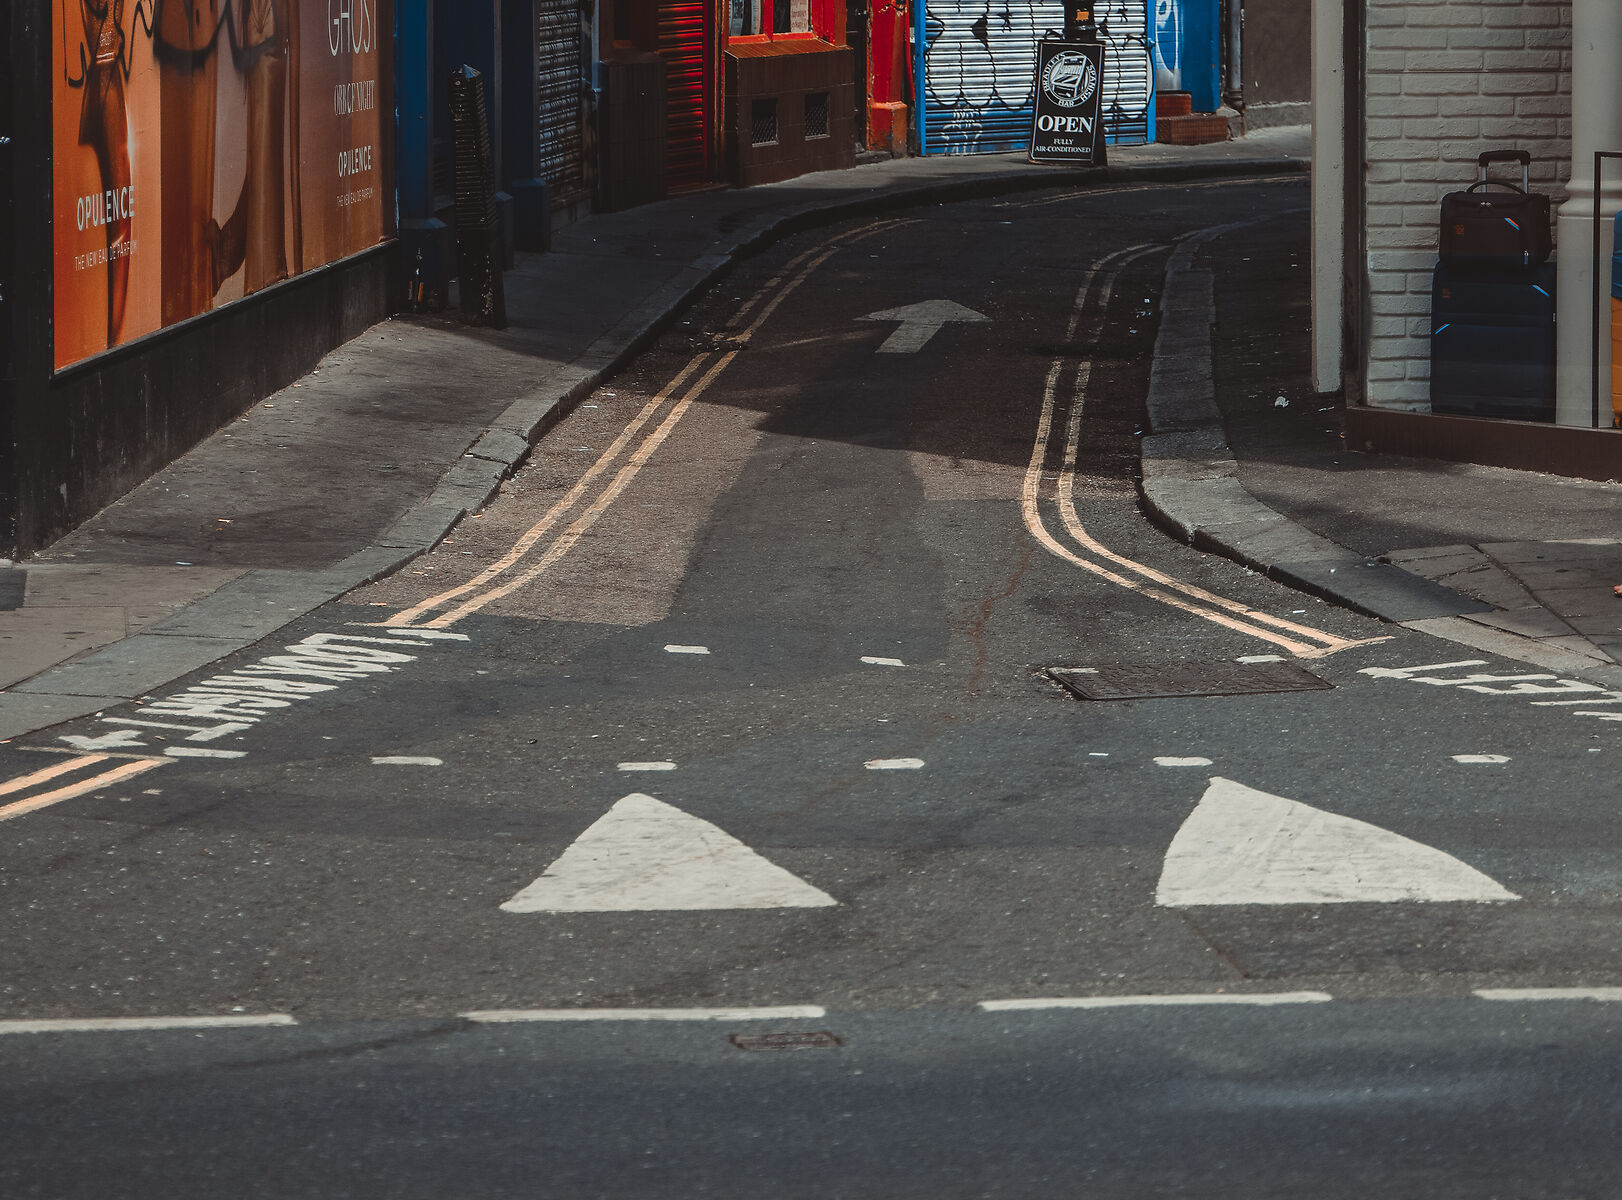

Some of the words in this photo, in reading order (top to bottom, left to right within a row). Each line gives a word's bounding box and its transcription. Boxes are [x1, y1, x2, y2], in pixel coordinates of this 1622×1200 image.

[1043, 53, 1066, 91] BRADLEYS
[1080, 65, 1098, 102] SPANISH
[1058, 99, 1075, 107] BAR
[1038, 114, 1093, 134] OPEN
[1034, 145, 1091, 153] AIR-CONDITIONED
[1053, 138, 1074, 146] FULLY
[338, 145, 372, 178] OPULENCE
[77, 185, 135, 231] OPULENCE
[75, 254, 85, 271] THE
[86, 250, 97, 267] NEW
[233, 632, 432, 681] LOOK
[100, 675, 340, 742] RIGHT
